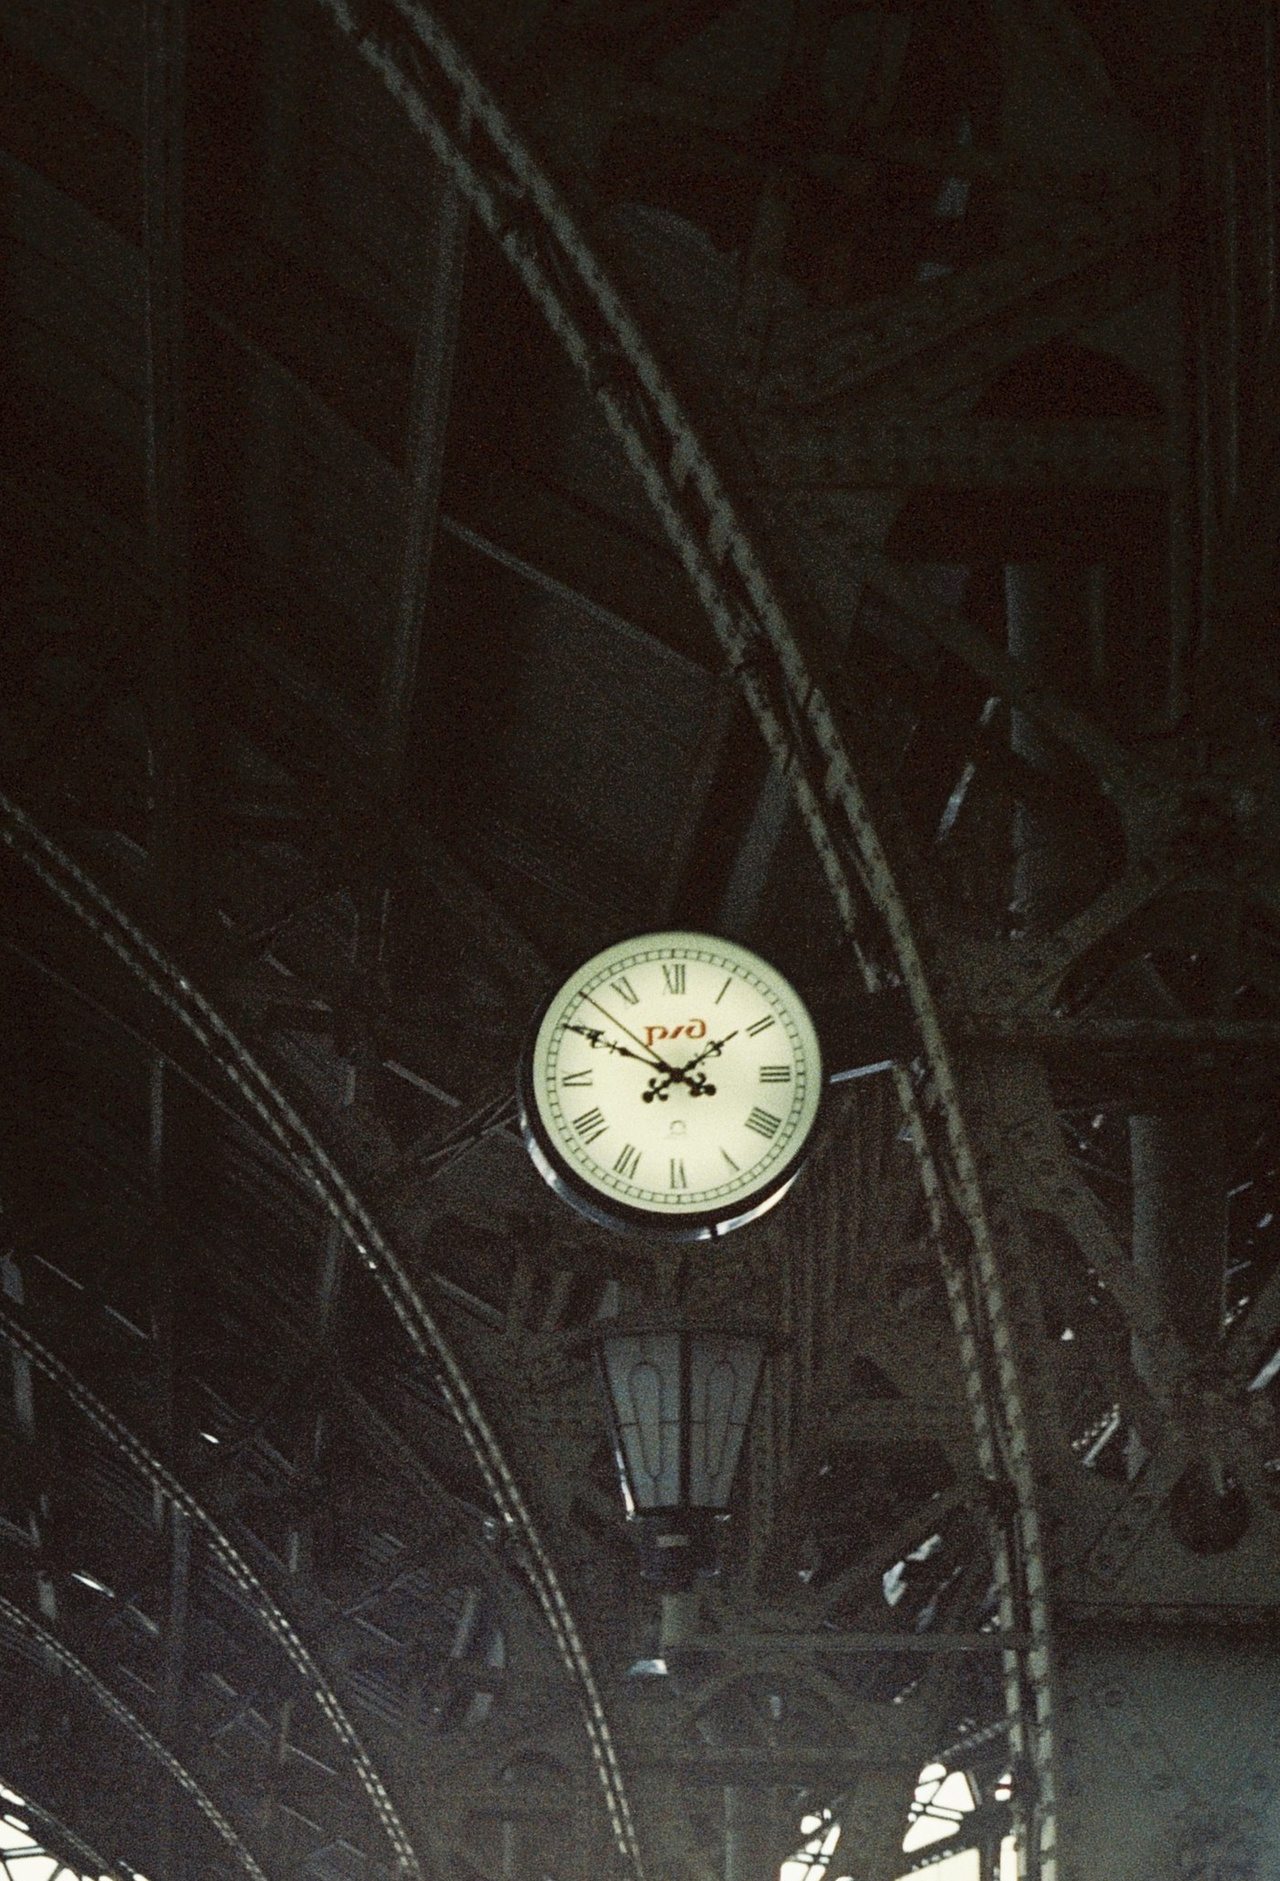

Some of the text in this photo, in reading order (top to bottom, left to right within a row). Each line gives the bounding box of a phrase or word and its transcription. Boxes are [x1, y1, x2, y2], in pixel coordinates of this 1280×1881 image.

[661, 963, 686, 994] XII
[714, 976, 733, 1005] I
[745, 1014, 776, 1038] II
[759, 1065, 791, 1083] III
[743, 1105, 782, 1140] IIII
